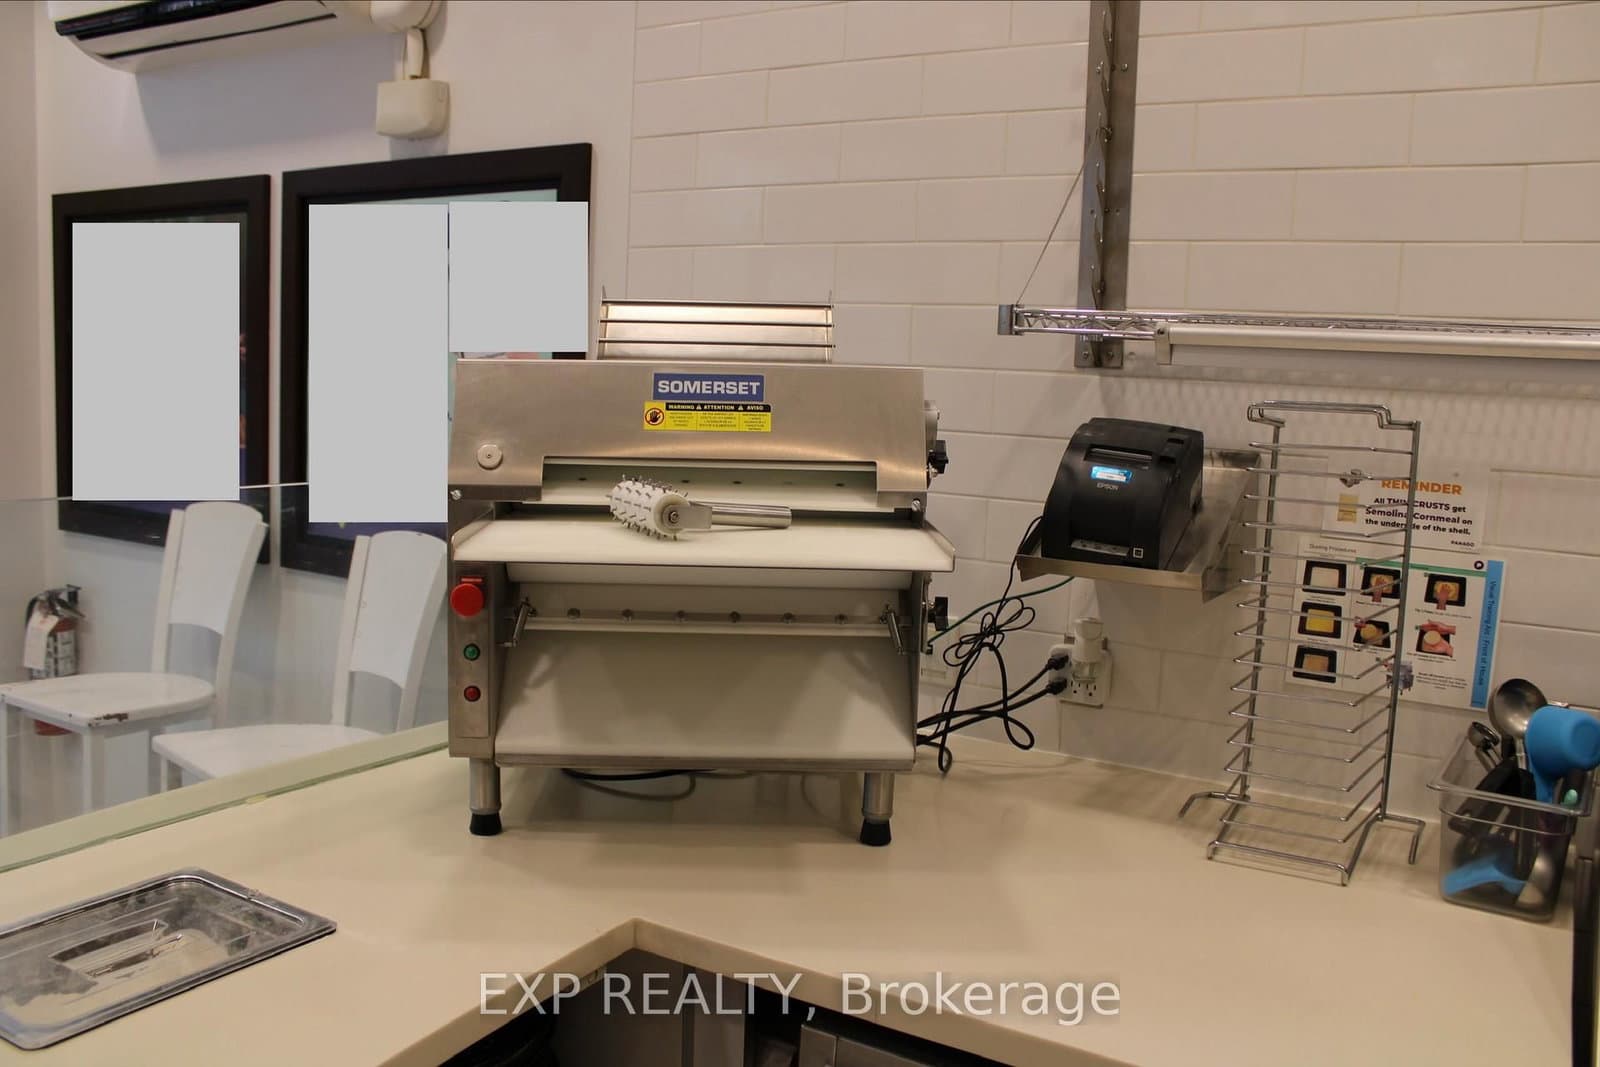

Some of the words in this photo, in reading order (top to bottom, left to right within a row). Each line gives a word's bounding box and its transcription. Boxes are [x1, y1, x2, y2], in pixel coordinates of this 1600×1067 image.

[658, 380, 760, 395] SOMERSET
[1381, 479, 1463, 495] REMNDER
[1413, 500, 1450, 511] CRUSTS
[1452, 505, 1466, 513] get
[1413, 512, 1460, 525] Cornmeal
[1365, 518, 1379, 526] the
[1433, 525, 1447, 533] the
[1449, 527, 1471, 536] shell.
